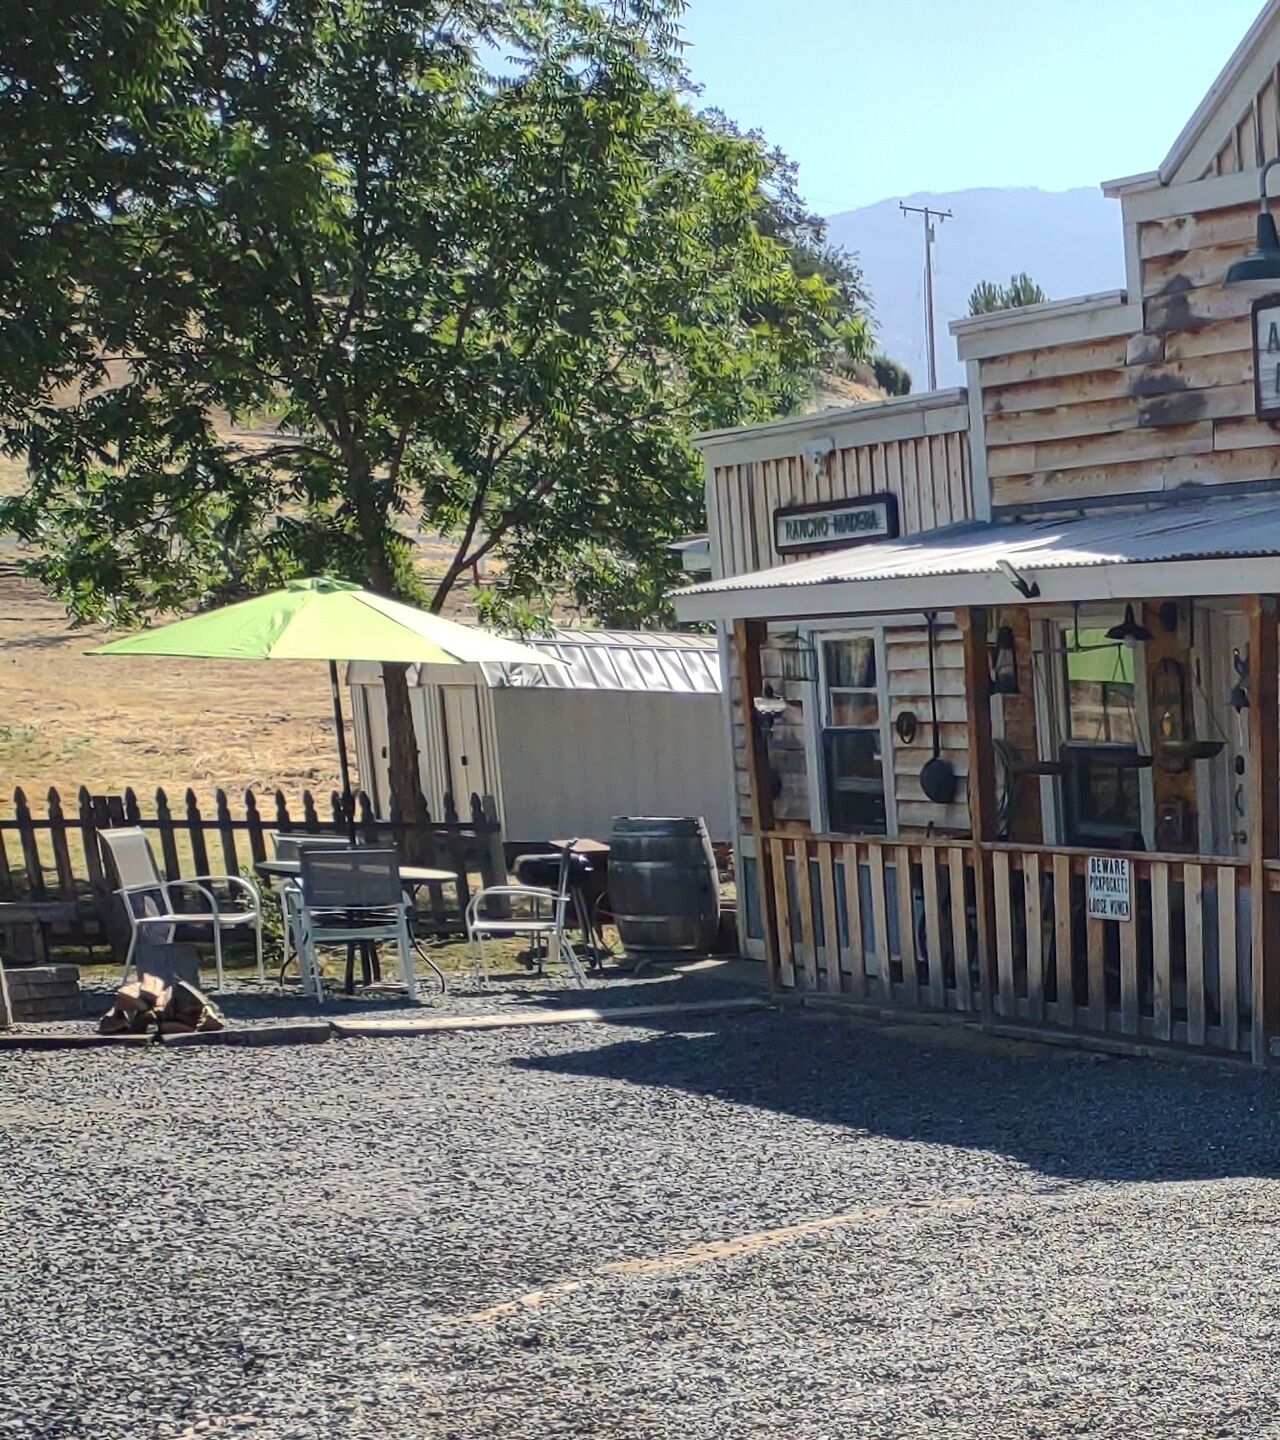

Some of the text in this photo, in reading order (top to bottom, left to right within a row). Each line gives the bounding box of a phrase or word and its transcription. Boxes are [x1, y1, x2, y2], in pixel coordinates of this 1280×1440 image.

[785, 516, 829, 540] RANCHO
[1091, 858, 1126, 875] BEWARE
[1090, 876, 1128, 894] PICKPOCKETS
[1089, 898, 1107, 913] LOOSE
